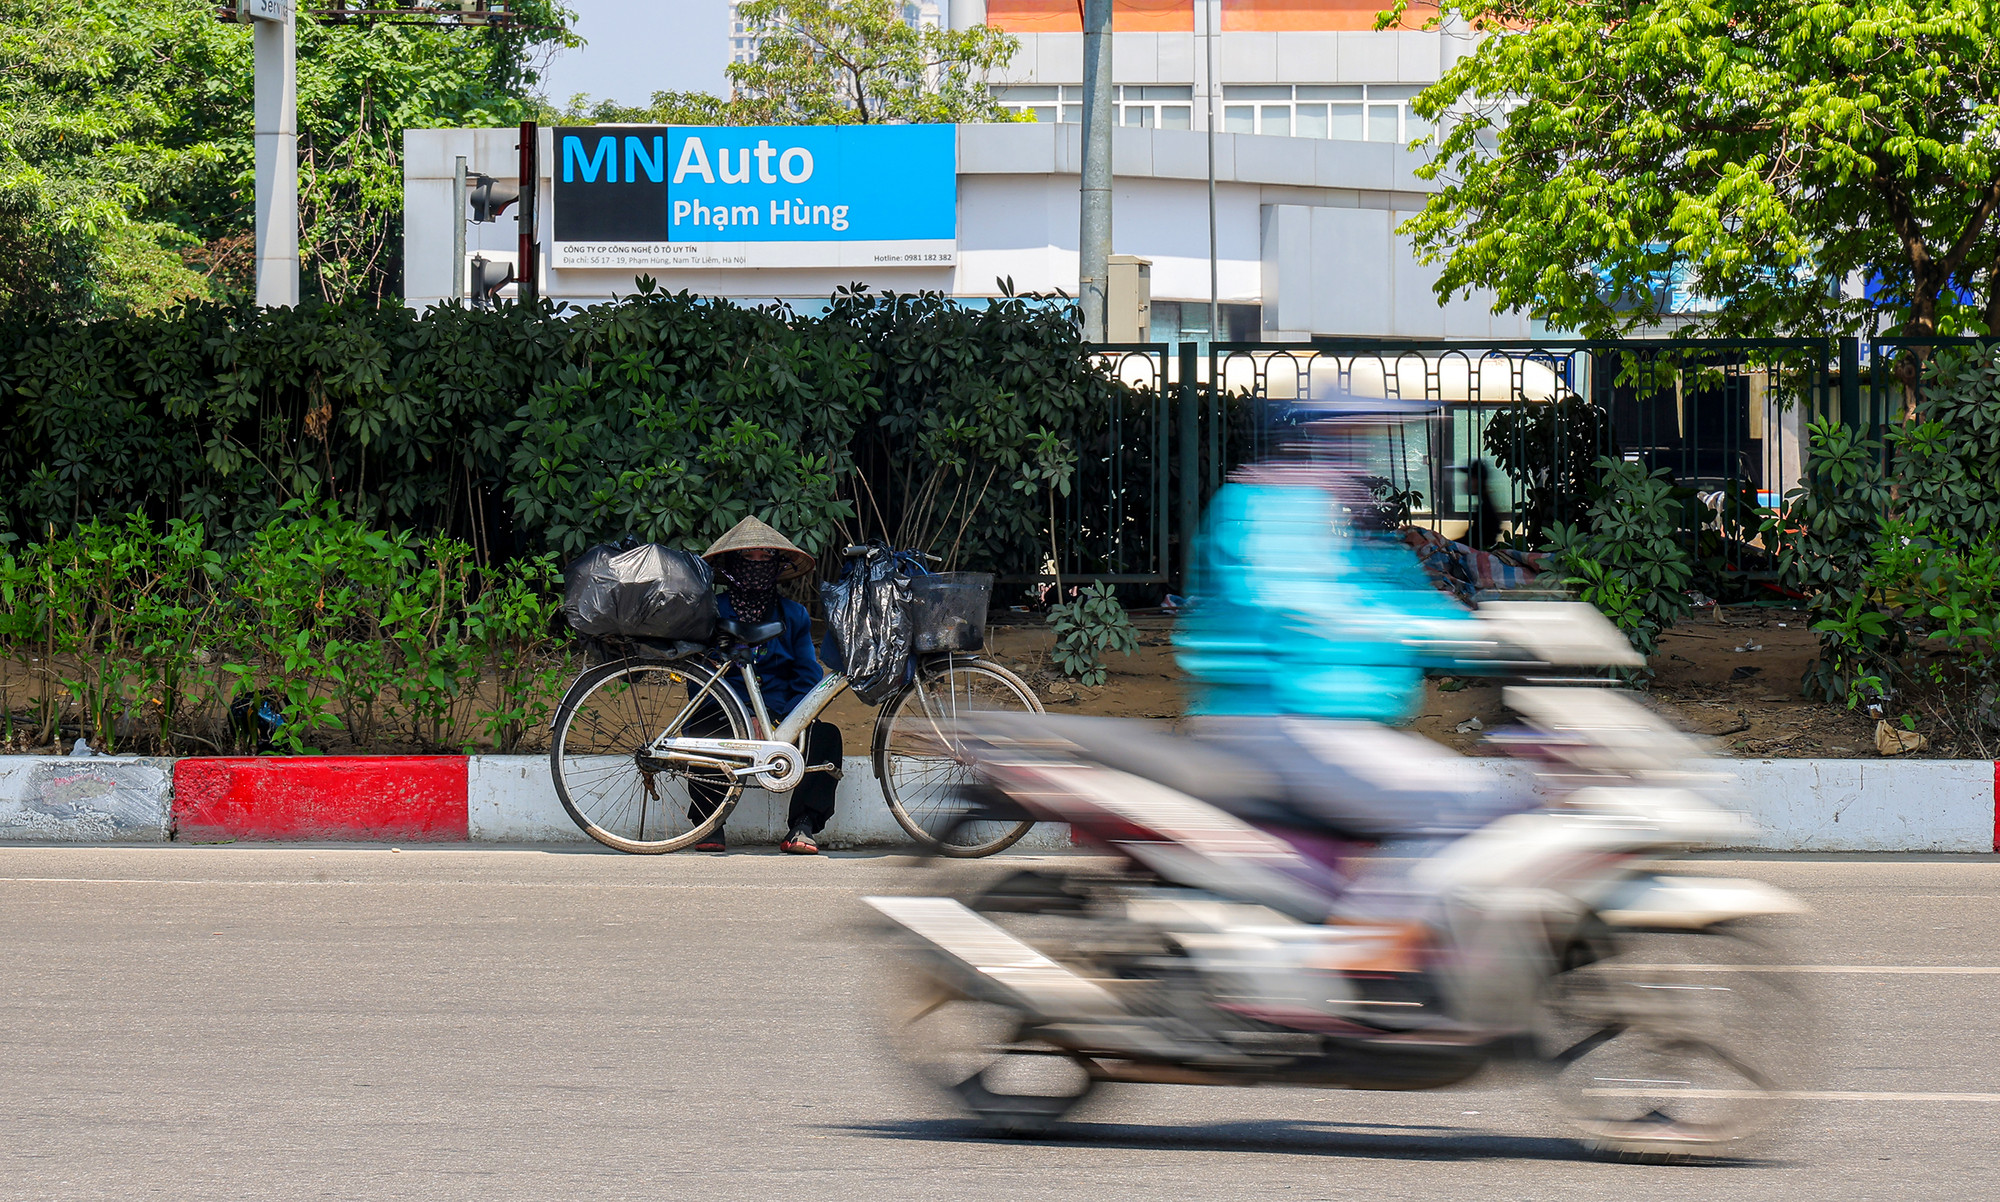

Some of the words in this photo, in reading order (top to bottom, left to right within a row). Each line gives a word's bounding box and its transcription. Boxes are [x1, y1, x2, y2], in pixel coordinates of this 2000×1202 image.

[673, 199, 760, 231] Phạm
[769, 197, 850, 232] Hùng
[563, 245, 585, 254] CÔNG
[587, 246, 596, 254] TY
[597, 246, 607, 254] CP
[608, 245, 630, 254] CÔNG
[631, 245, 652, 255] NGHỆ
[653, 245, 660, 254] Ô
[661, 245, 672, 254] TÔ
[673, 245, 684, 254] UY
[685, 245, 697, 254] TÍN
[563, 256, 575, 265] Địa
[576, 256, 589, 264] chỉ:
[590, 256, 600, 264] Số
[616, 257, 627, 265] 19,
[628, 256, 649, 265] Phạm
[650, 256, 671, 265] Hùng,
[672, 256, 690, 264] Nam
[691, 255, 701, 264] Từ
[701, 255, 721, 265] Liêm,
[722, 256, 733, 264] Hà
[733, 256, 747, 265] Nội
[874, 254, 903, 262] Hotline:
[904, 253, 922, 261] 0981
[924, 253, 937, 261] 182
[938, 253, 952, 261] 382
